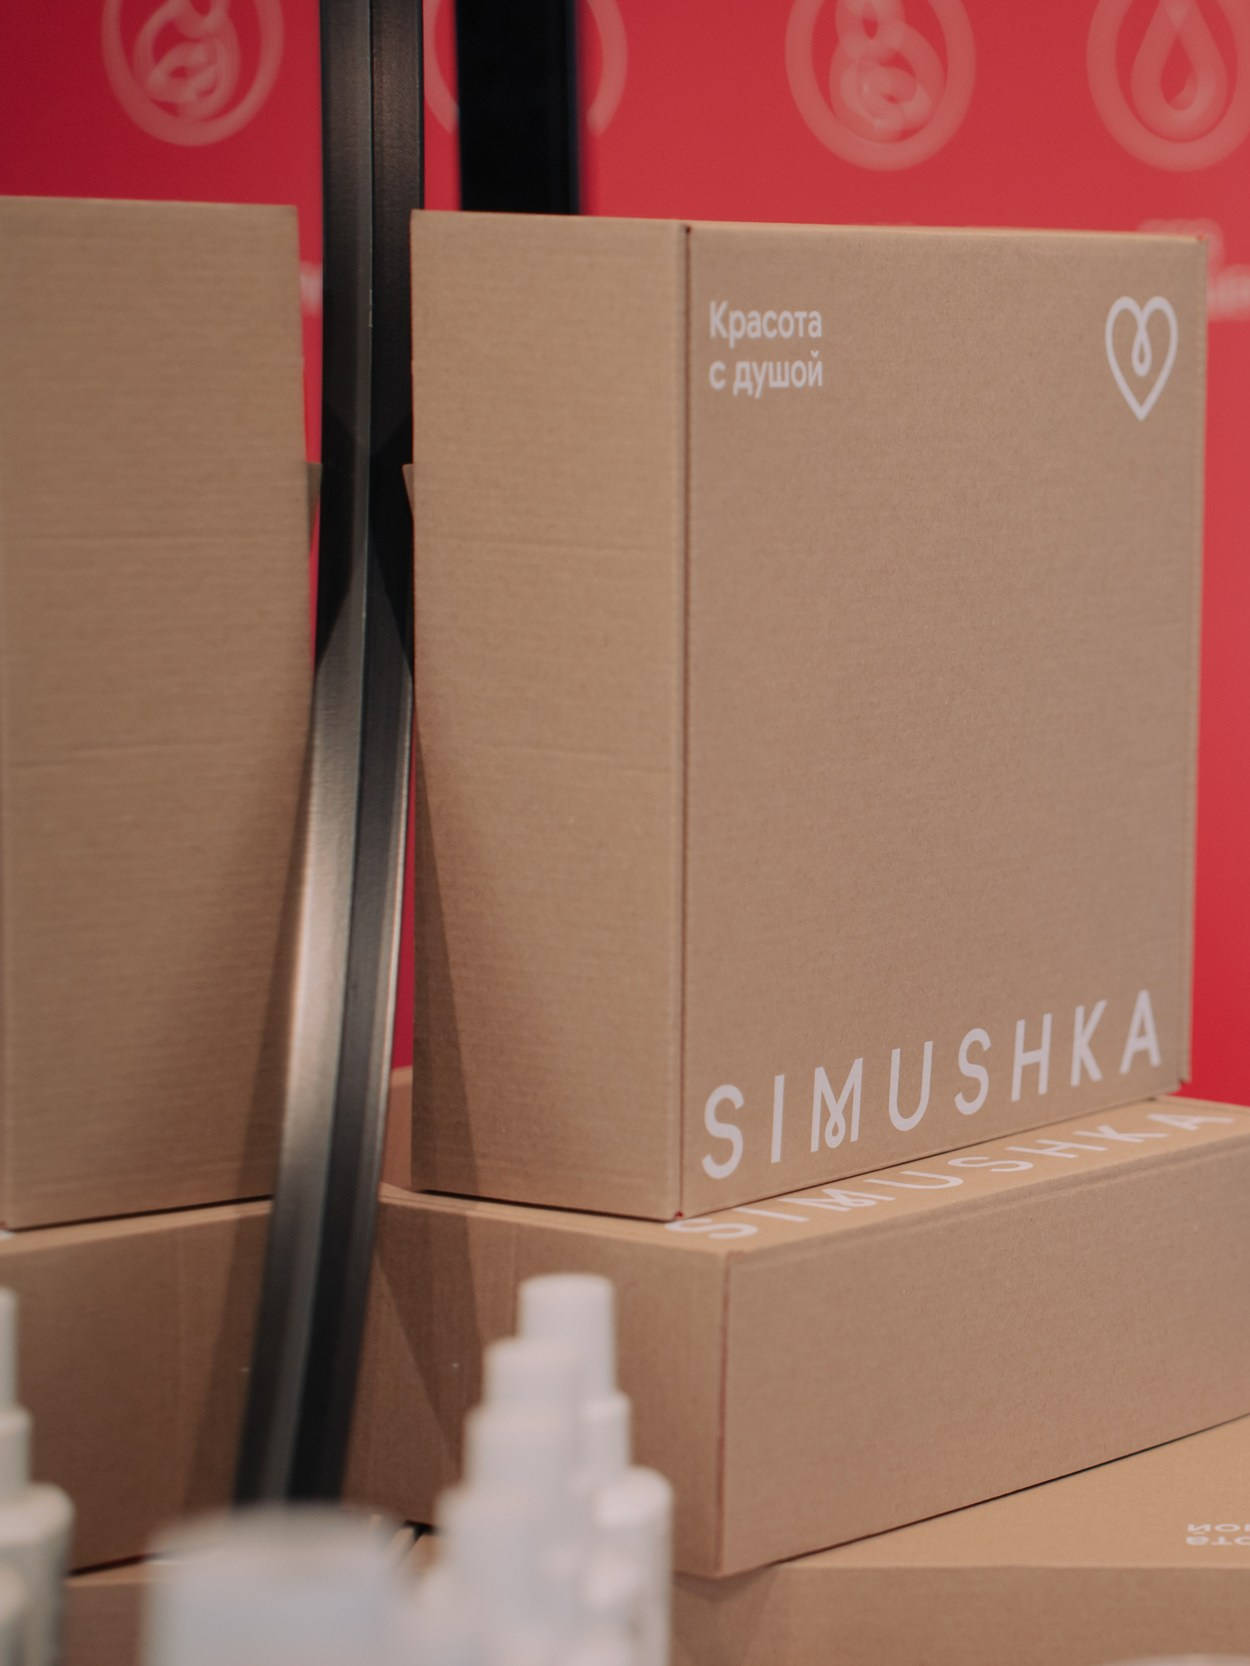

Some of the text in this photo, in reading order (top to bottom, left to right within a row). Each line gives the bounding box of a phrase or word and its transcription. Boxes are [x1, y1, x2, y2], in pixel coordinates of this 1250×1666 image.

[709, 300, 823, 348] Красота
[709, 350, 824, 398] с душой
[701, 989, 1162, 1180] SIMUSHKA
[665, 1113, 1234, 1239] SIMUSHKA
